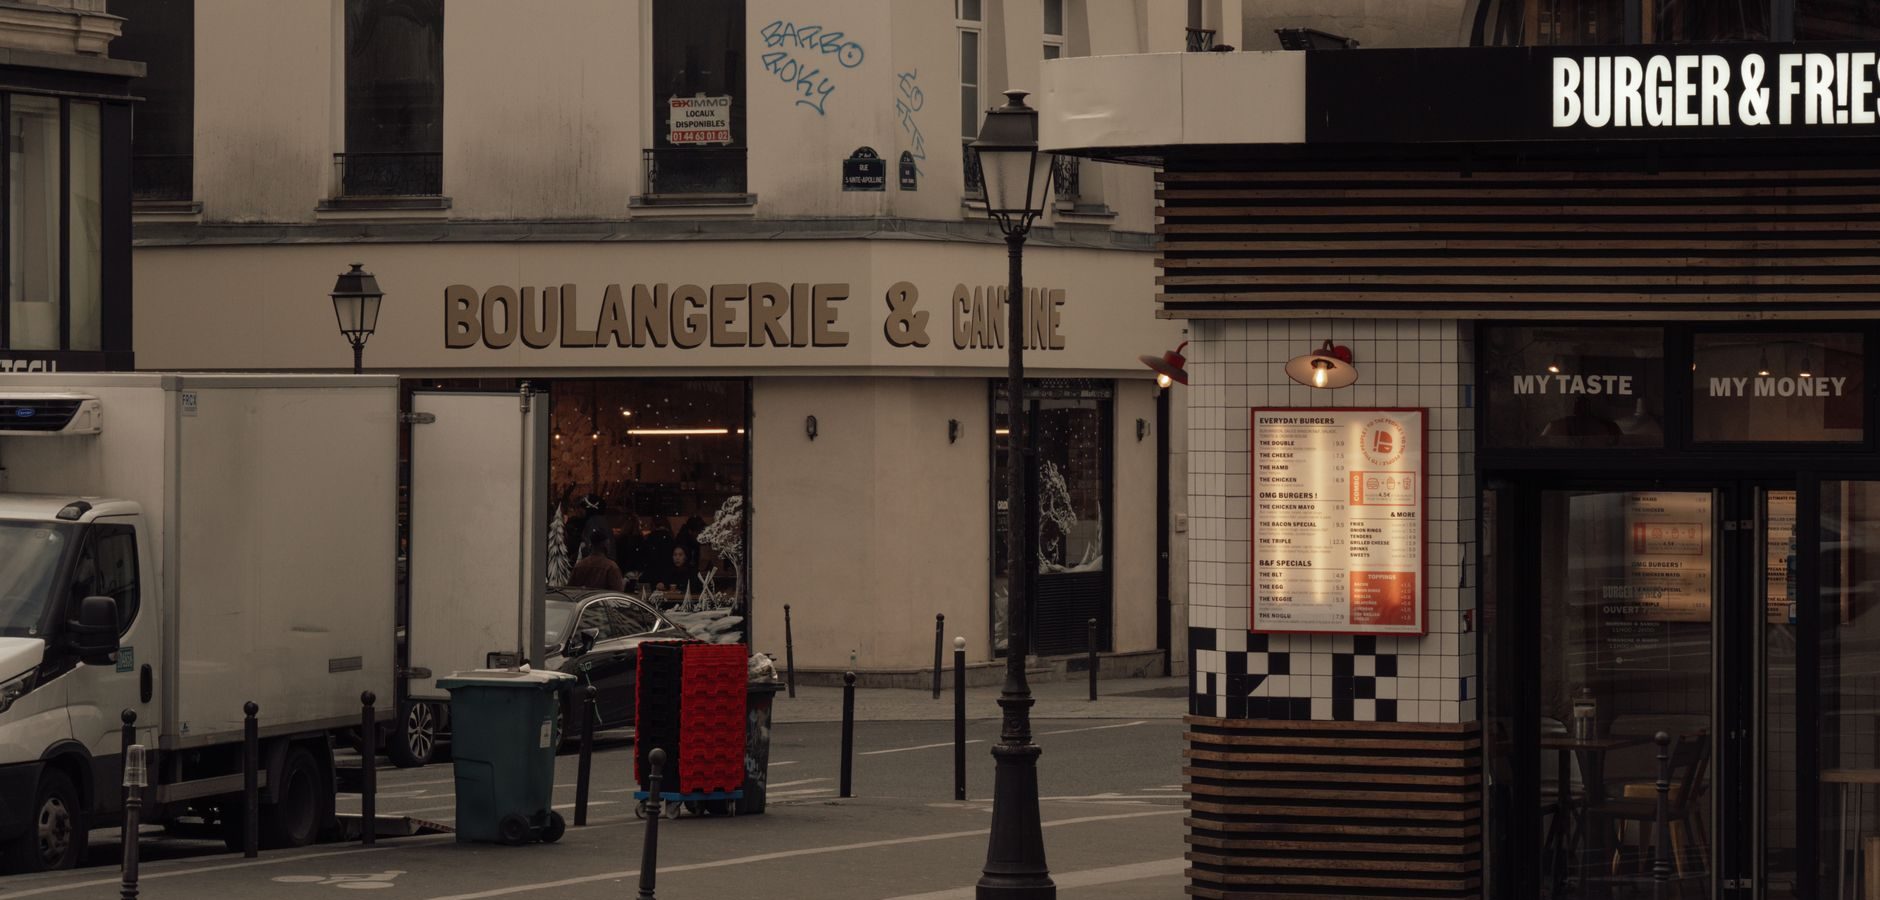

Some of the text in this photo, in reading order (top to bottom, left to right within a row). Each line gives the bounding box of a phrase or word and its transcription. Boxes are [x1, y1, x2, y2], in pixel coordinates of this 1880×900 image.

[1553, 52, 1880, 127] BURGER & FR!E
[686, 110, 715, 118] LOCAUX
[676, 120, 726, 128] DISPONIBLES
[673, 132, 682, 140] 01
[683, 132, 694, 140] 44
[695, 132, 705, 140] 63
[718, 131, 728, 139] 02
[445, 281, 1065, 350] BOULANGERIE & CANINE
[1513, 375, 1633, 395] MY TASTE
[1710, 376, 1846, 397] MY MONEY
[1603, 606, 1639, 614] OUVERT
